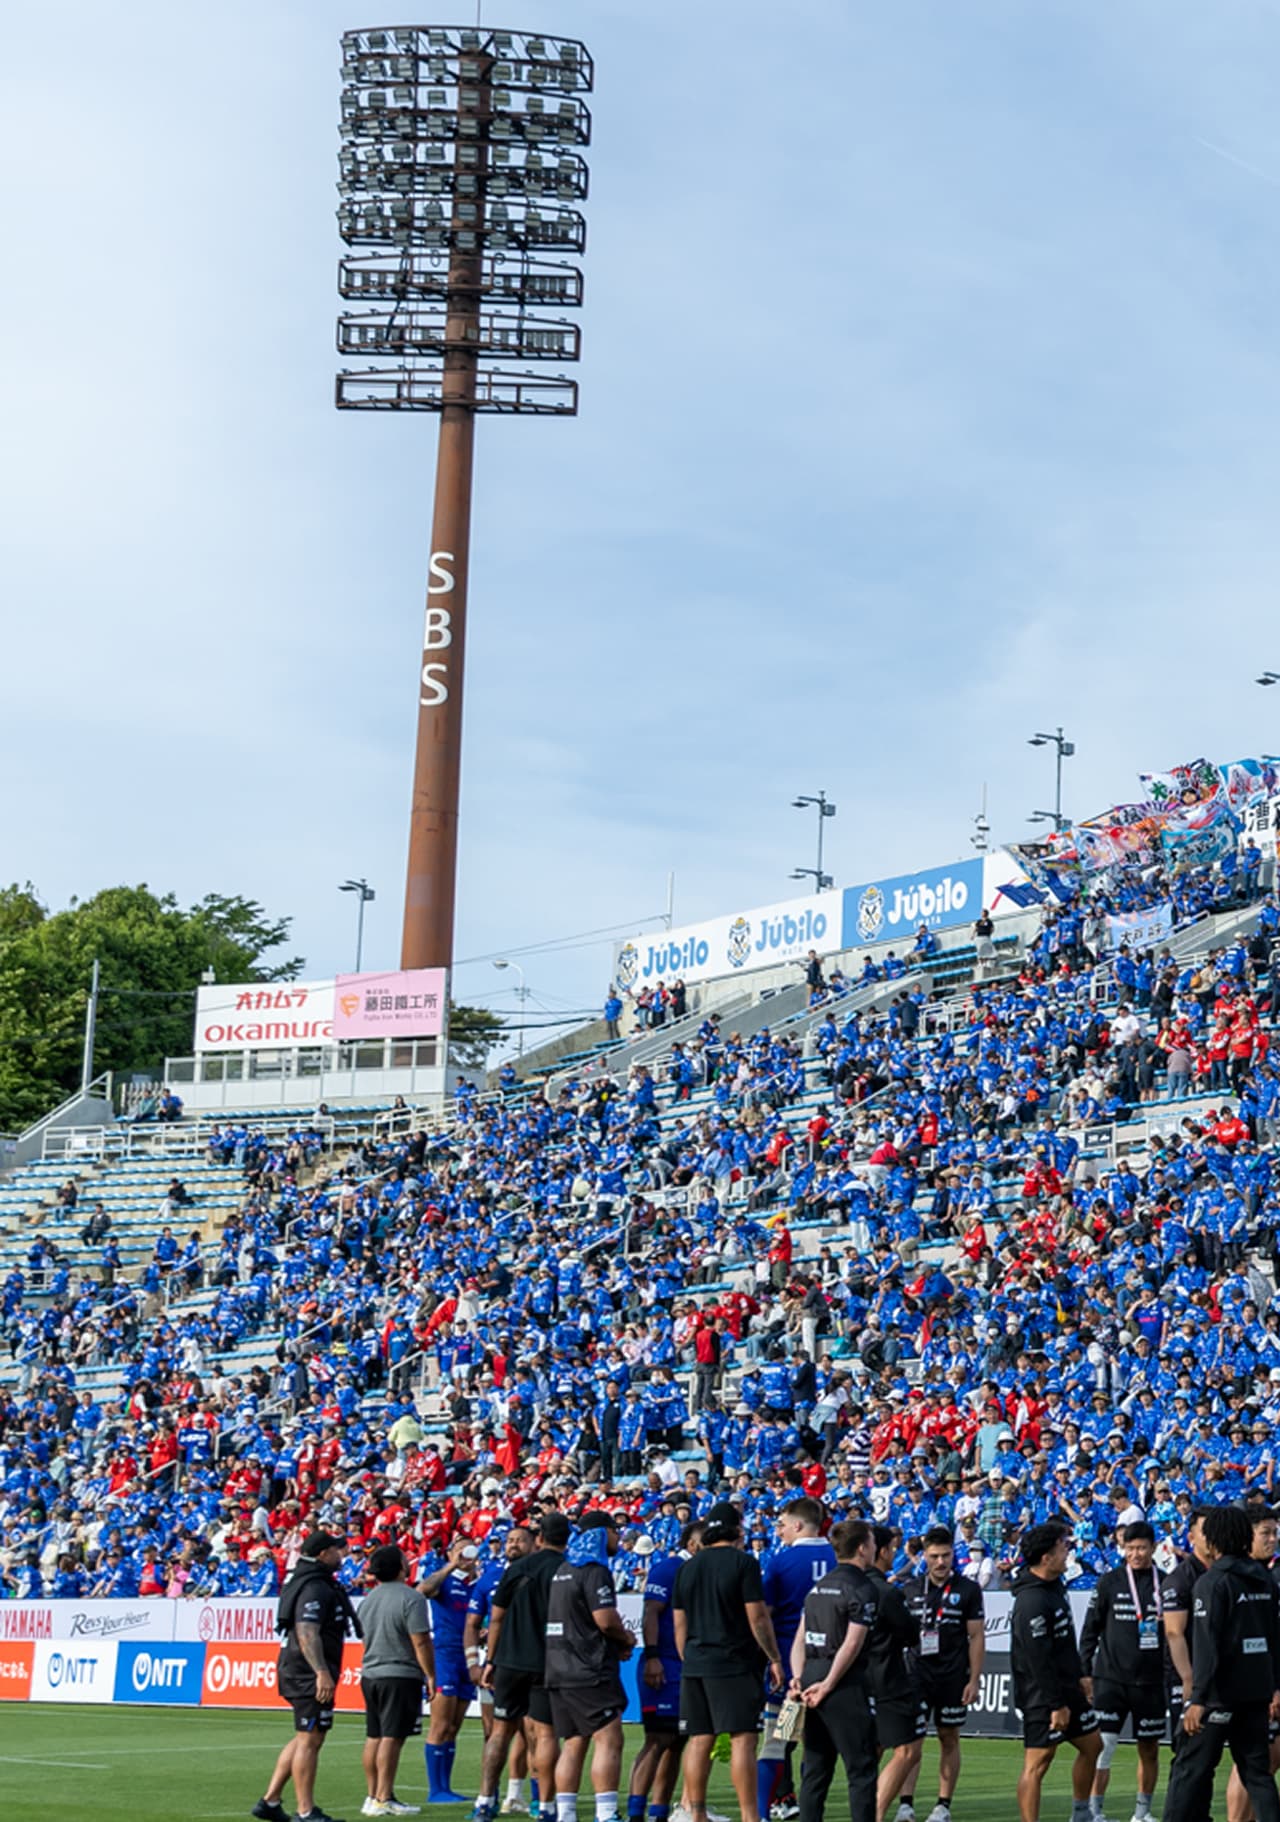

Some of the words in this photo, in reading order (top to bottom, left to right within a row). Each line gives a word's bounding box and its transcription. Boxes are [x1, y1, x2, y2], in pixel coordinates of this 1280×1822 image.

[420, 551, 456, 706] SBS
[888, 878, 968, 925] Júbilo
[756, 910, 828, 951] Júbilo
[643, 935, 709, 978] Júbilo
[235, 989, 308, 1011] オカムラ
[4, 1609, 52, 1638] YAMAHA
[216, 1608, 274, 1640] YAMAHA
[65, 1659, 98, 1684] NTT
[152, 1659, 188, 1687] NTT
[232, 1661, 276, 1689] MUFG
[968, 1673, 1011, 1713] GUE
